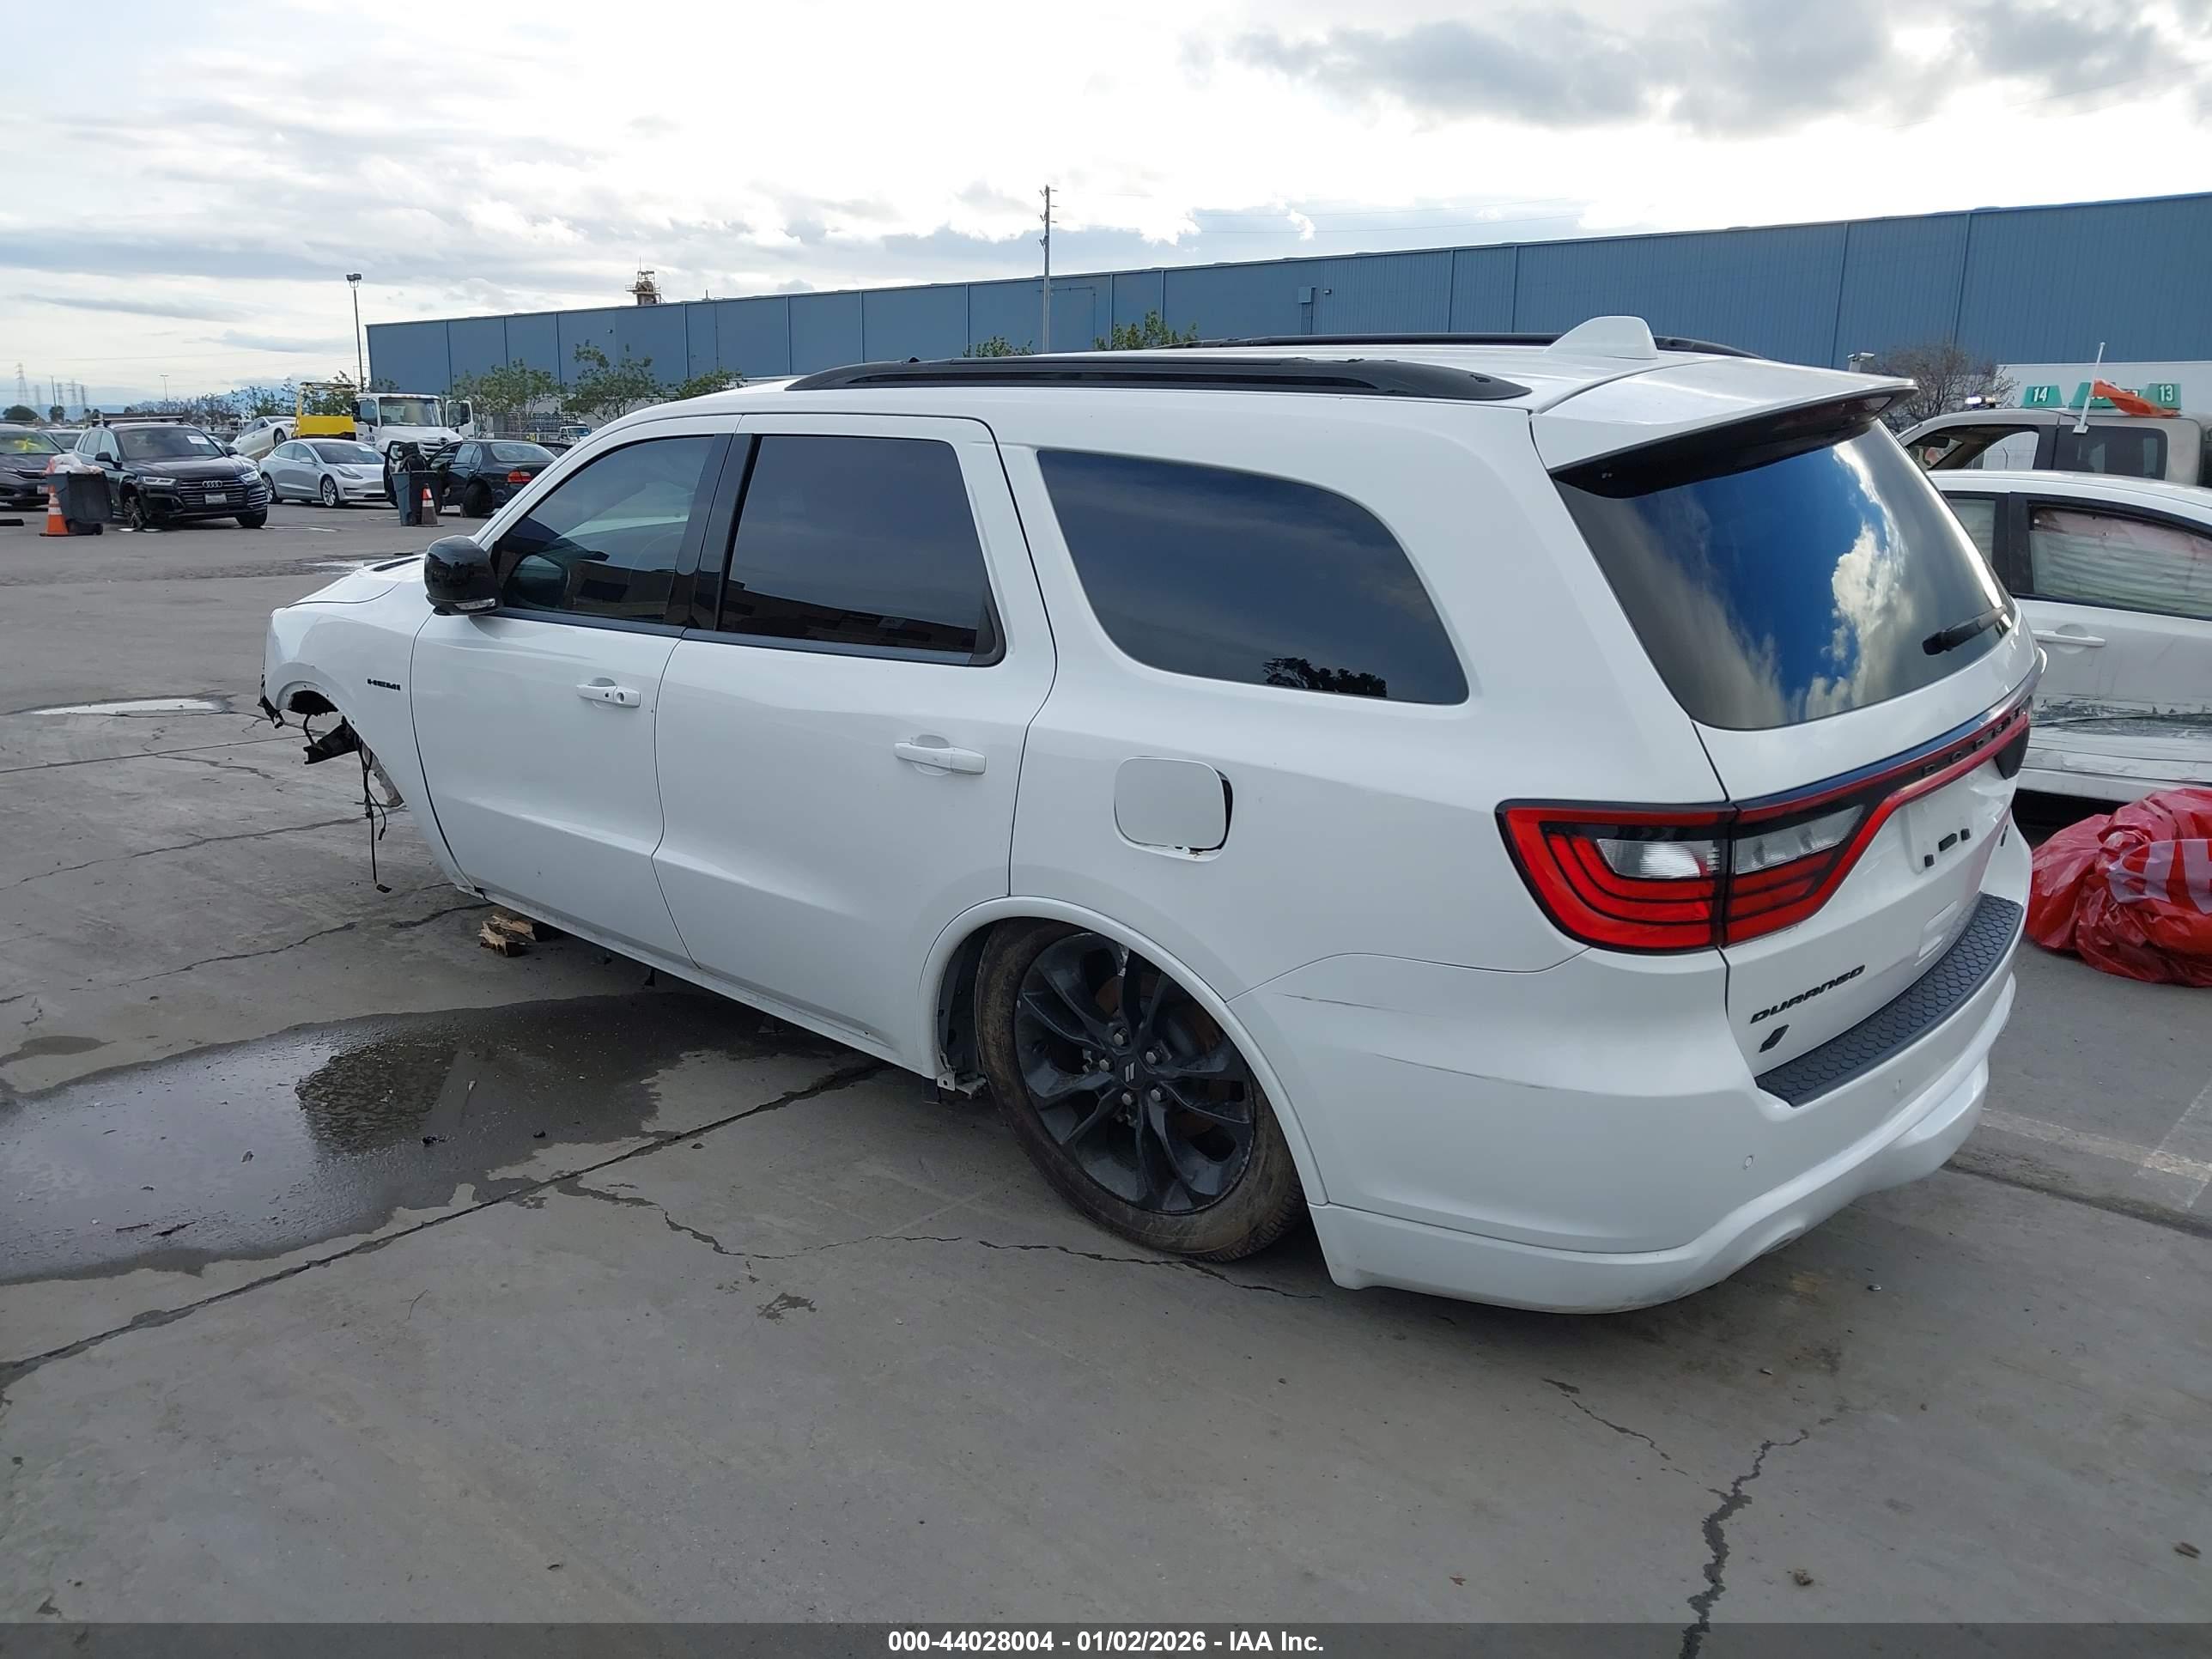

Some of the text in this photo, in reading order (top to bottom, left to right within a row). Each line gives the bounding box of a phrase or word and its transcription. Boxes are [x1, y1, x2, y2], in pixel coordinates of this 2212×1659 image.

[2033, 387, 2048, 402] 14
[2160, 385, 2172, 402] 13
[1750, 964, 1866, 1024] DURANGO
